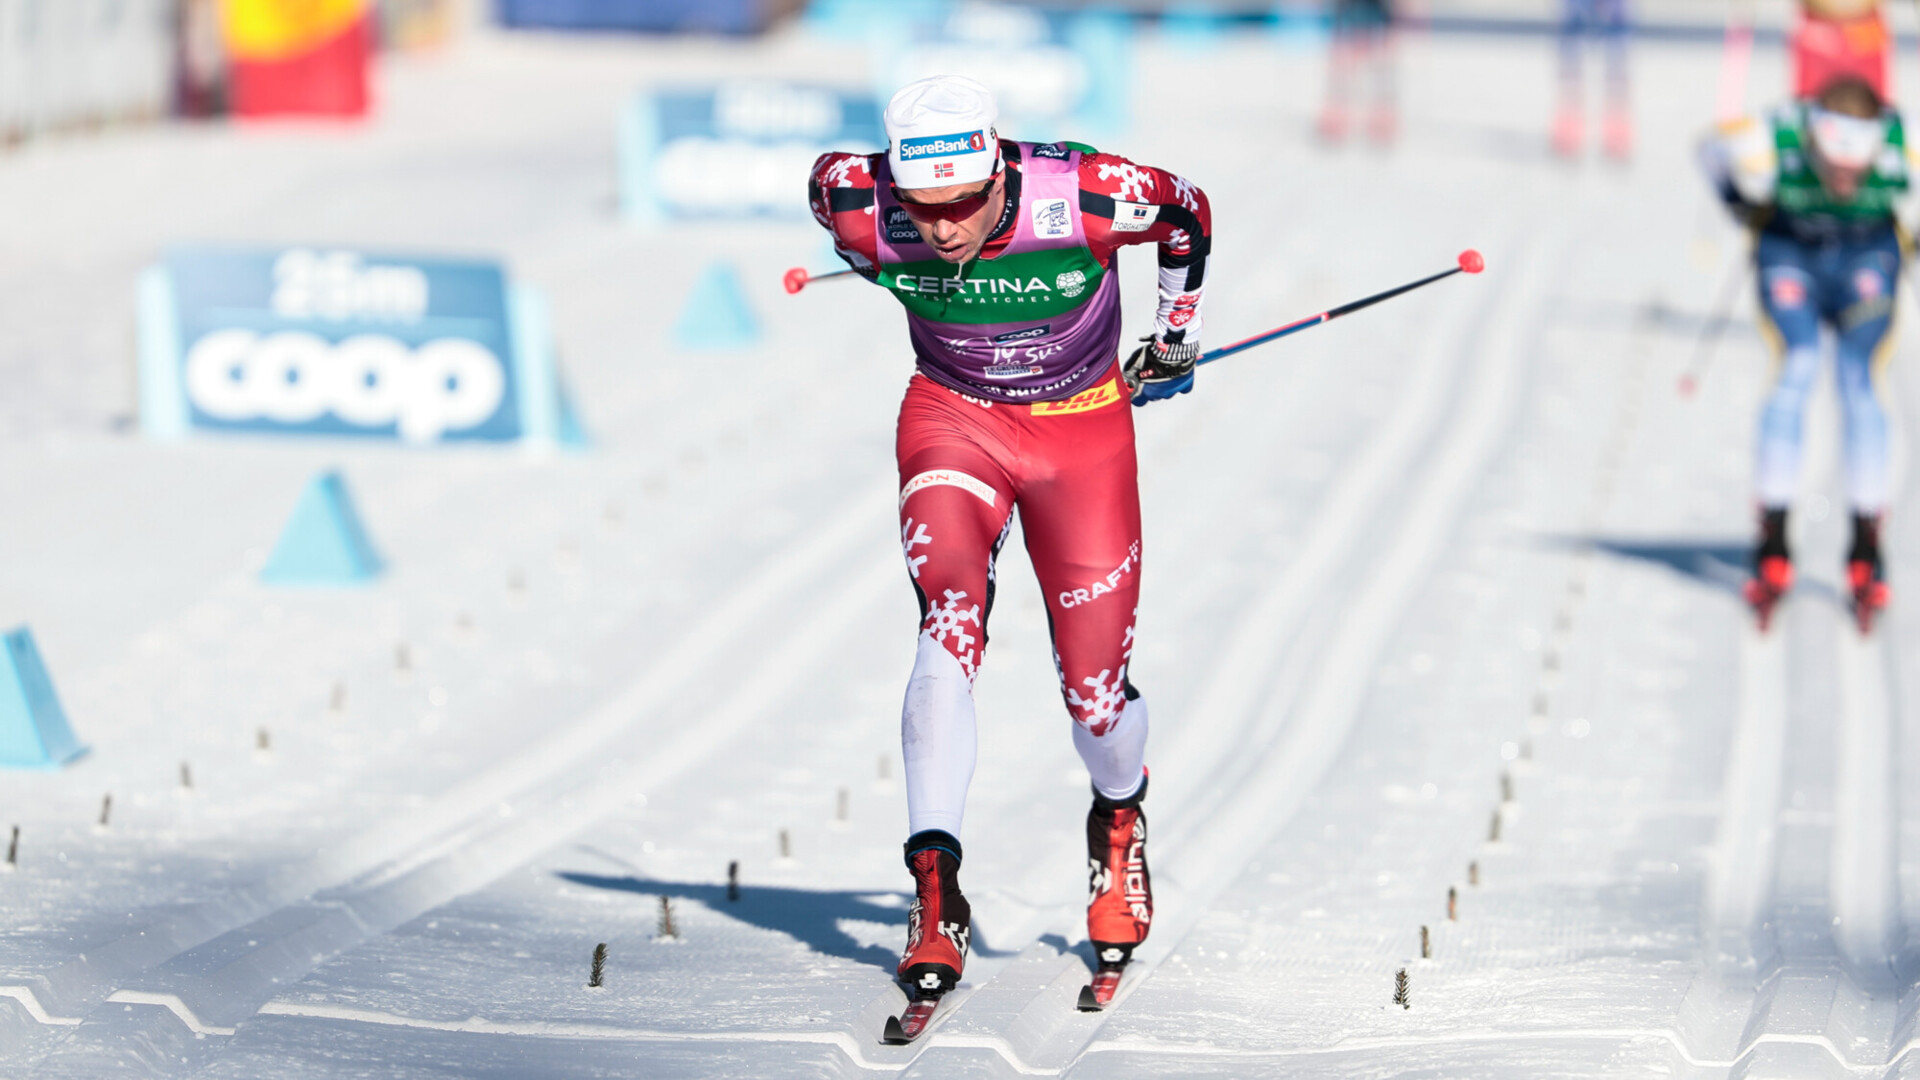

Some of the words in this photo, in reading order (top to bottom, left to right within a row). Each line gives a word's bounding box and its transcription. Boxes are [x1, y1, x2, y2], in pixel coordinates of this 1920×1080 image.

[901, 138, 969, 158] SpareBank
[892, 230, 918, 239] coop
[896, 274, 1052, 294] CERTINA
[964, 295, 1050, 304] WATCHES
[186, 328, 505, 444] coop
[1046, 387, 1110, 411] DHL
[1059, 556, 1131, 608] CRAFT
